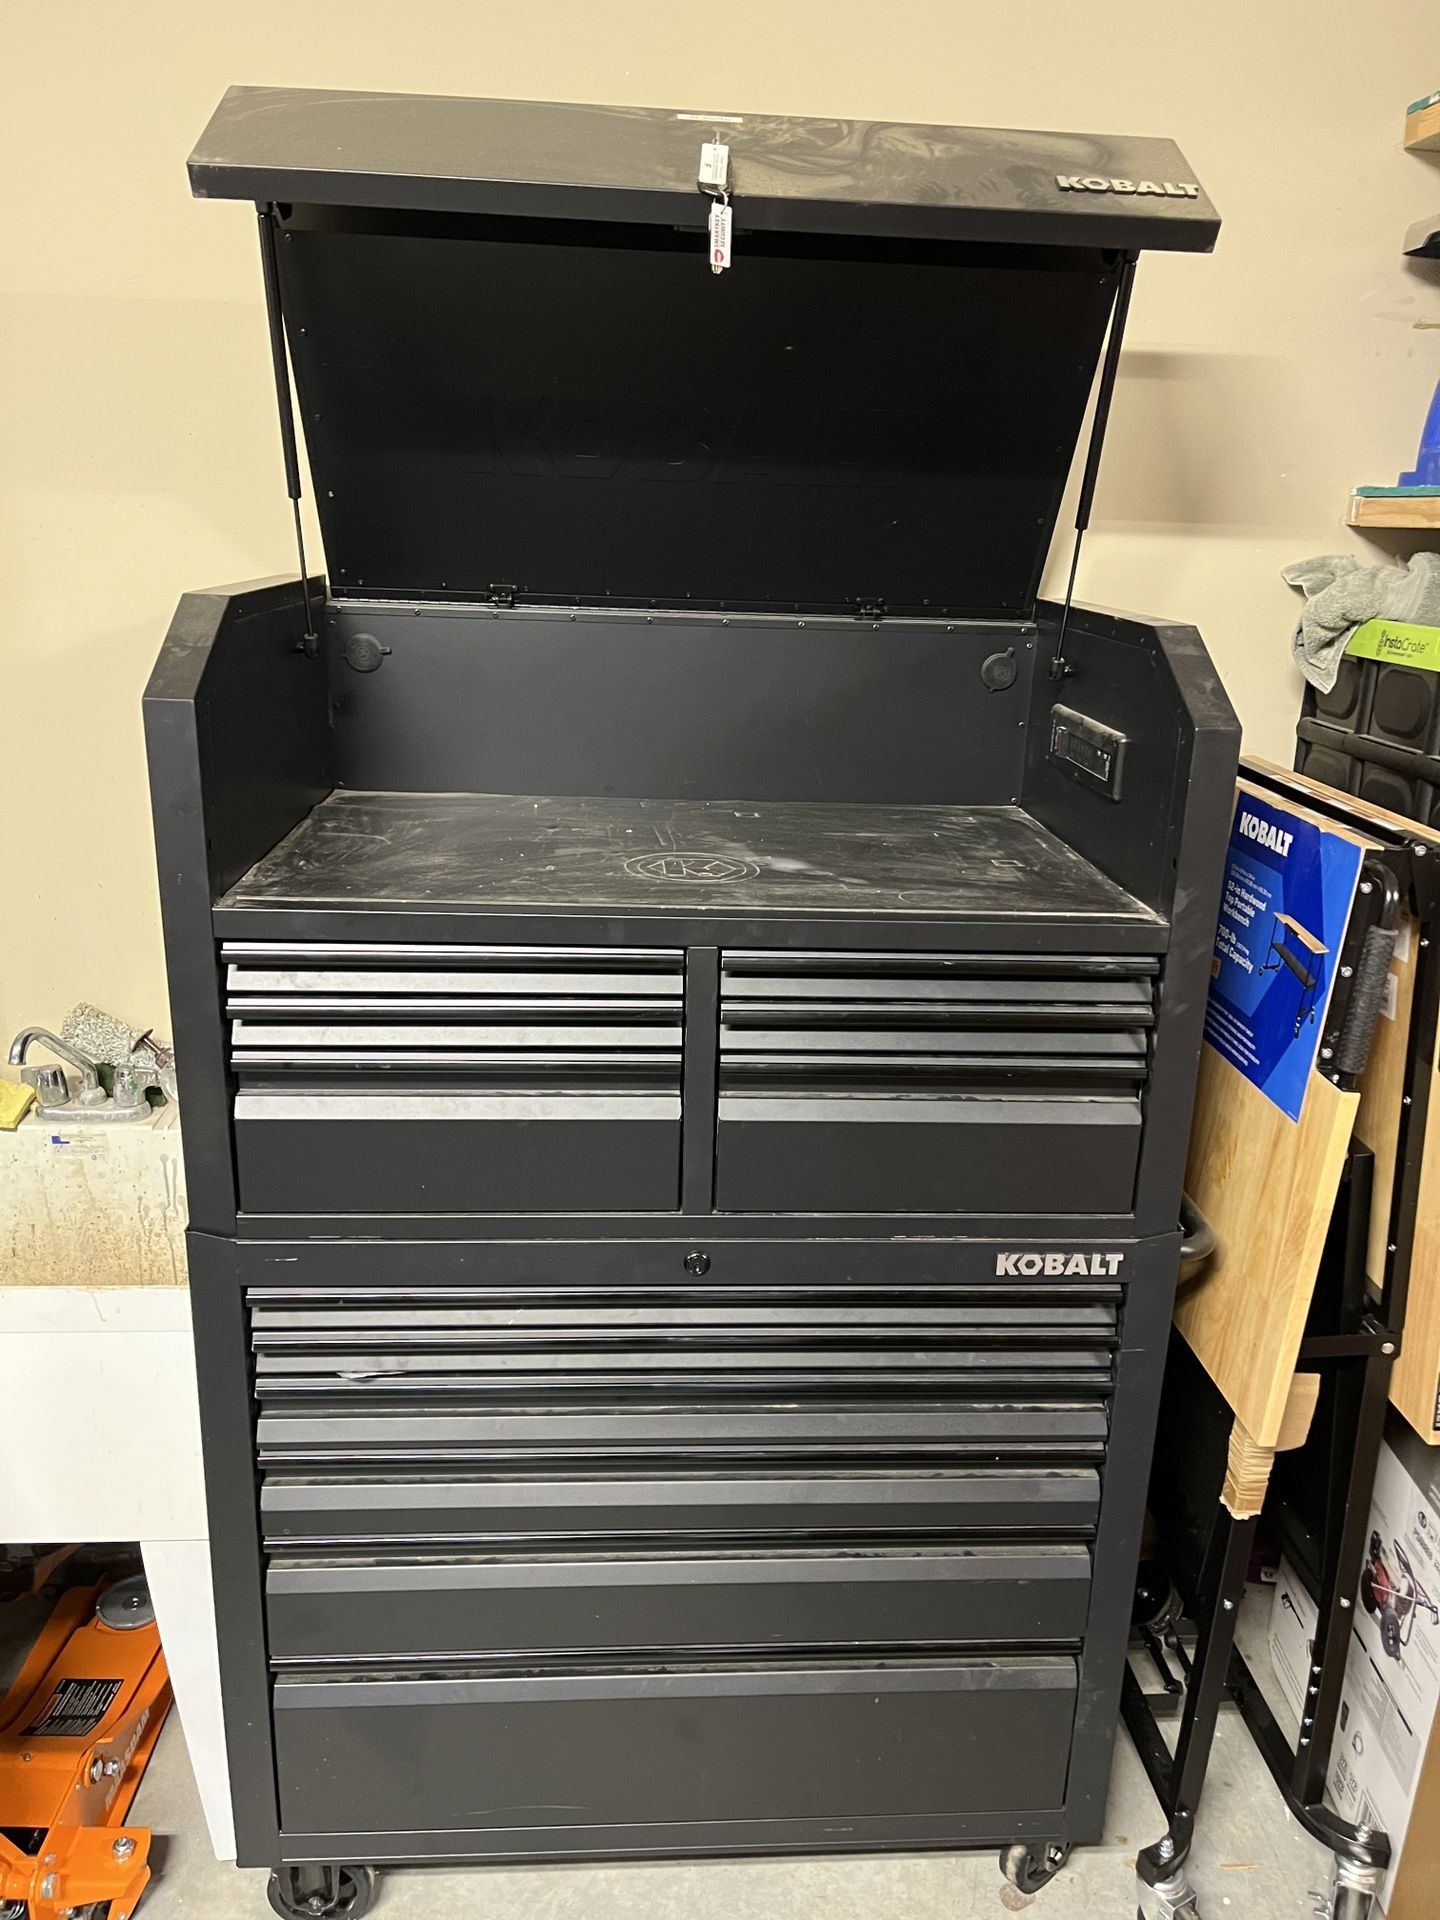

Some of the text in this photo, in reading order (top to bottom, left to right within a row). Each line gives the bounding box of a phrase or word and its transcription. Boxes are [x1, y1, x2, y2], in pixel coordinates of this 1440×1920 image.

[1055, 175, 1199, 199] KOBALT
[1239, 811, 1293, 857] KOBALT
[1225, 891, 1255, 917] Top Portable
[1240, 888, 1267, 911] Hardwood
[1223, 902, 1250, 927] Workbench
[1216, 937, 1229, 954] Total
[1229, 947, 1253, 974] Capacity
[996, 1253, 1124, 1276] KOBALT
